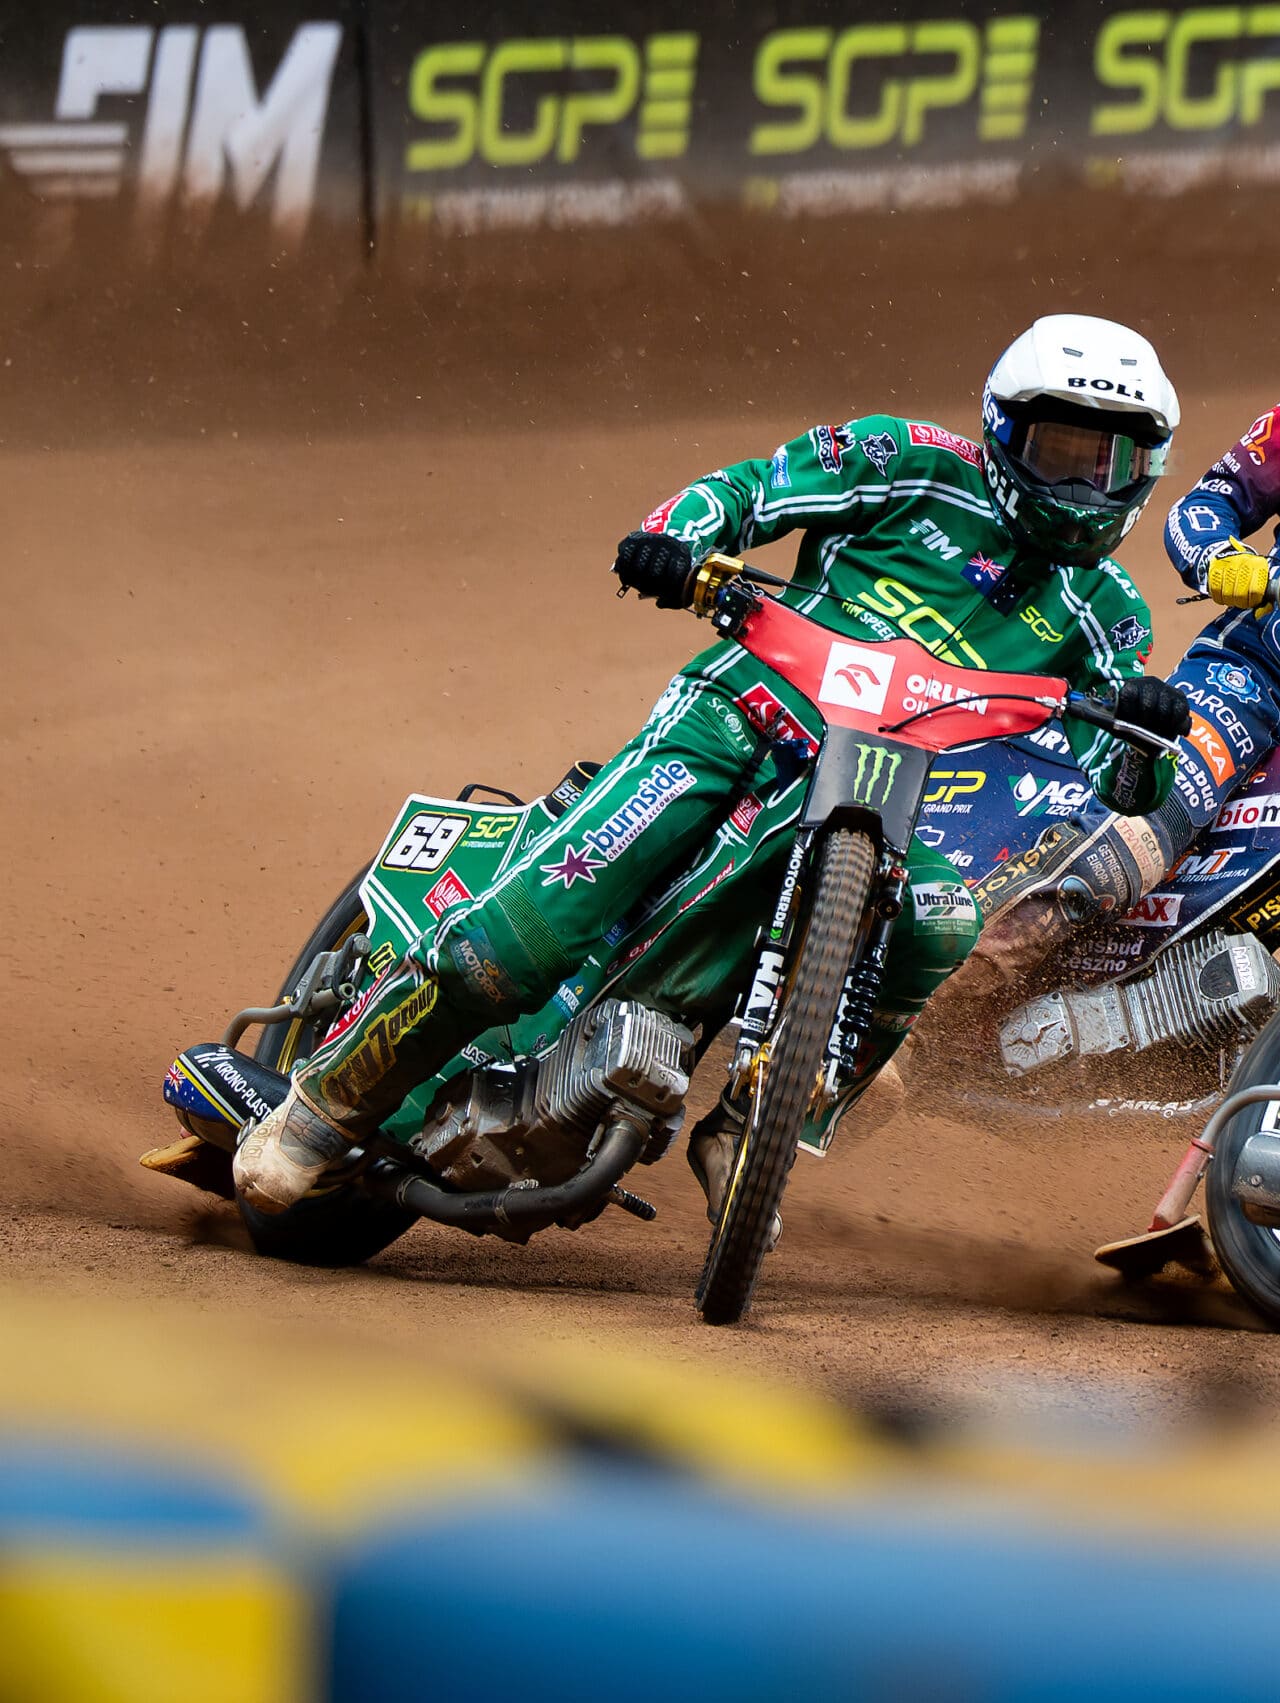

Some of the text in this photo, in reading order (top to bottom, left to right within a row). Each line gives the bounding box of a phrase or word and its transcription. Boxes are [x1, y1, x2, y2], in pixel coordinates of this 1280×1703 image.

[909, 518, 963, 561] FIM
[906, 674, 989, 715] ORLEN
[1174, 681, 1255, 759] CARGER
[468, 816, 518, 838] SGP
[586, 762, 687, 852] burnside
[923, 804, 974, 814] GRAND PRIX
[384, 813, 470, 870] 69
[608, 819, 648, 860] chartered
[773, 843, 805, 929] MOTOVERDE
[1086, 852, 1110, 887] EUROPA
